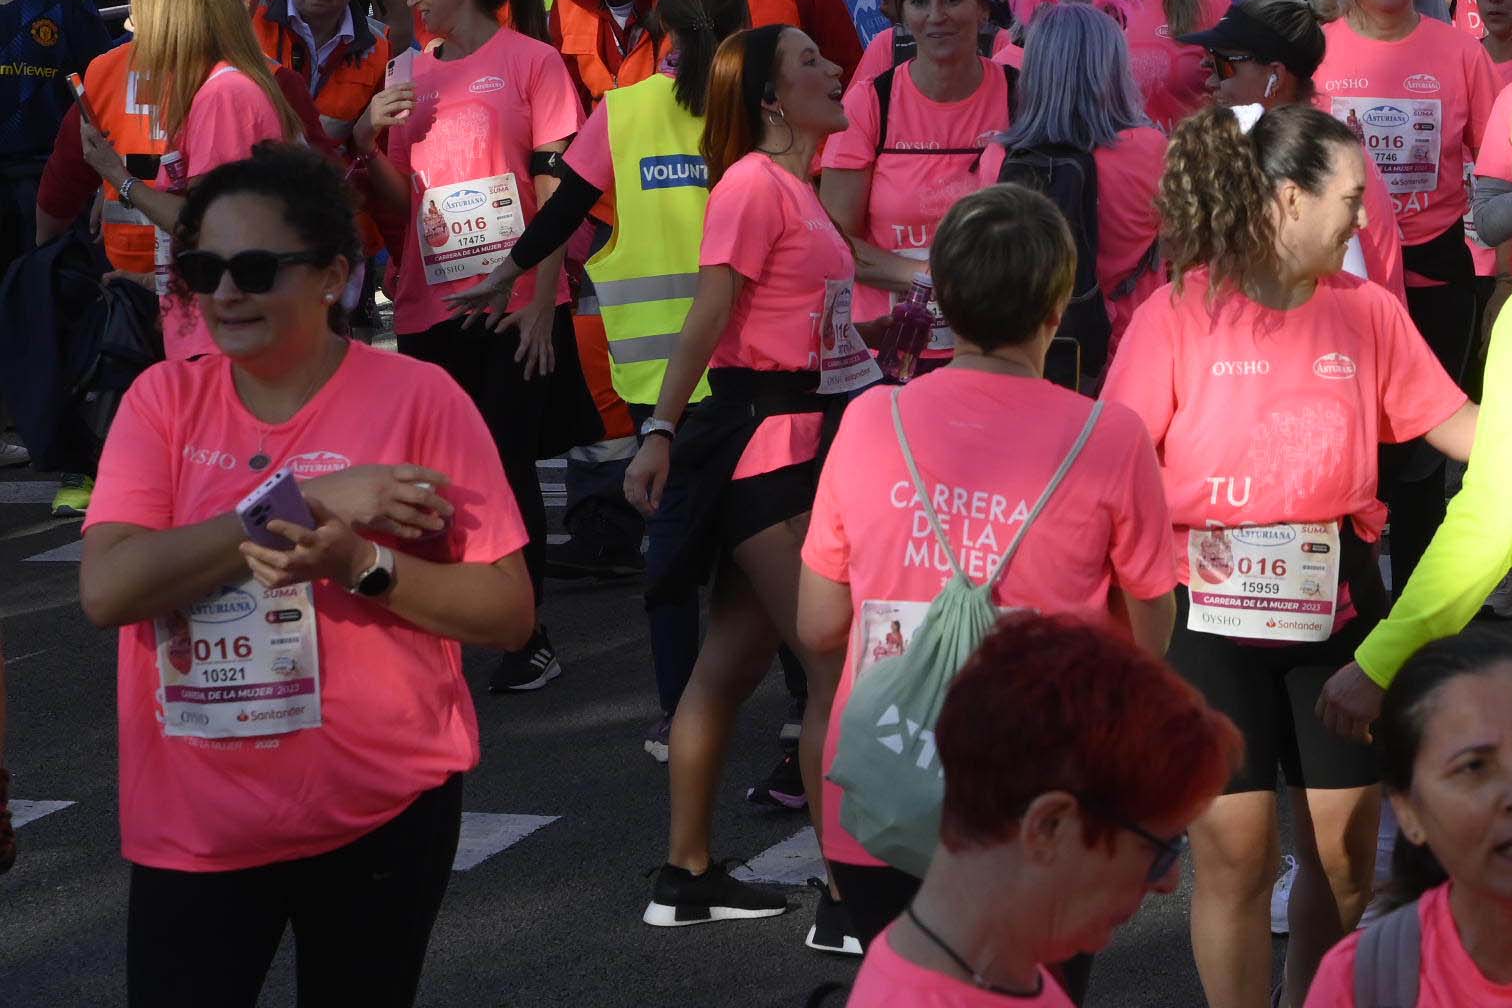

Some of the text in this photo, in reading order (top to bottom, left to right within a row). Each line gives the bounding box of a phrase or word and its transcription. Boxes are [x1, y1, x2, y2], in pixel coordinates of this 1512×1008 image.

[1325, 79, 1369, 91] OYSHO
[1368, 134, 1404, 149] 016
[1375, 152, 1397, 162] 7746
[643, 164, 708, 181] VOLUNT
[445, 194, 484, 210] ASTURIANA
[452, 216, 487, 235] 016
[457, 234, 486, 247] 17475
[892, 224, 927, 247] TU
[434, 250, 462, 263] CARRERA
[462, 248, 472, 258] DE
[472, 246, 481, 256] LA
[481, 243, 502, 254] MUJER
[1212, 359, 1270, 377] OYSHO
[1206, 476, 1252, 507] TU
[890, 480, 1033, 526] CARRERA
[962, 517, 999, 552] LA
[1237, 526, 1291, 541] ASTURIANA
[1302, 525, 1328, 535] SUMA
[1237, 556, 1287, 577] 016
[1241, 581, 1280, 595] 15959
[1204, 595, 1321, 612] CARRERA DE LA MUJER 2023
[1202, 611, 1241, 627] OYSHO
[1278, 618, 1323, 632] Santander
[193, 635, 252, 662] 016
[202, 667, 246, 683] 10321
[223, 689, 236, 700] LA
[237, 686, 273, 699] MUJER
[250, 704, 306, 721] Santander
